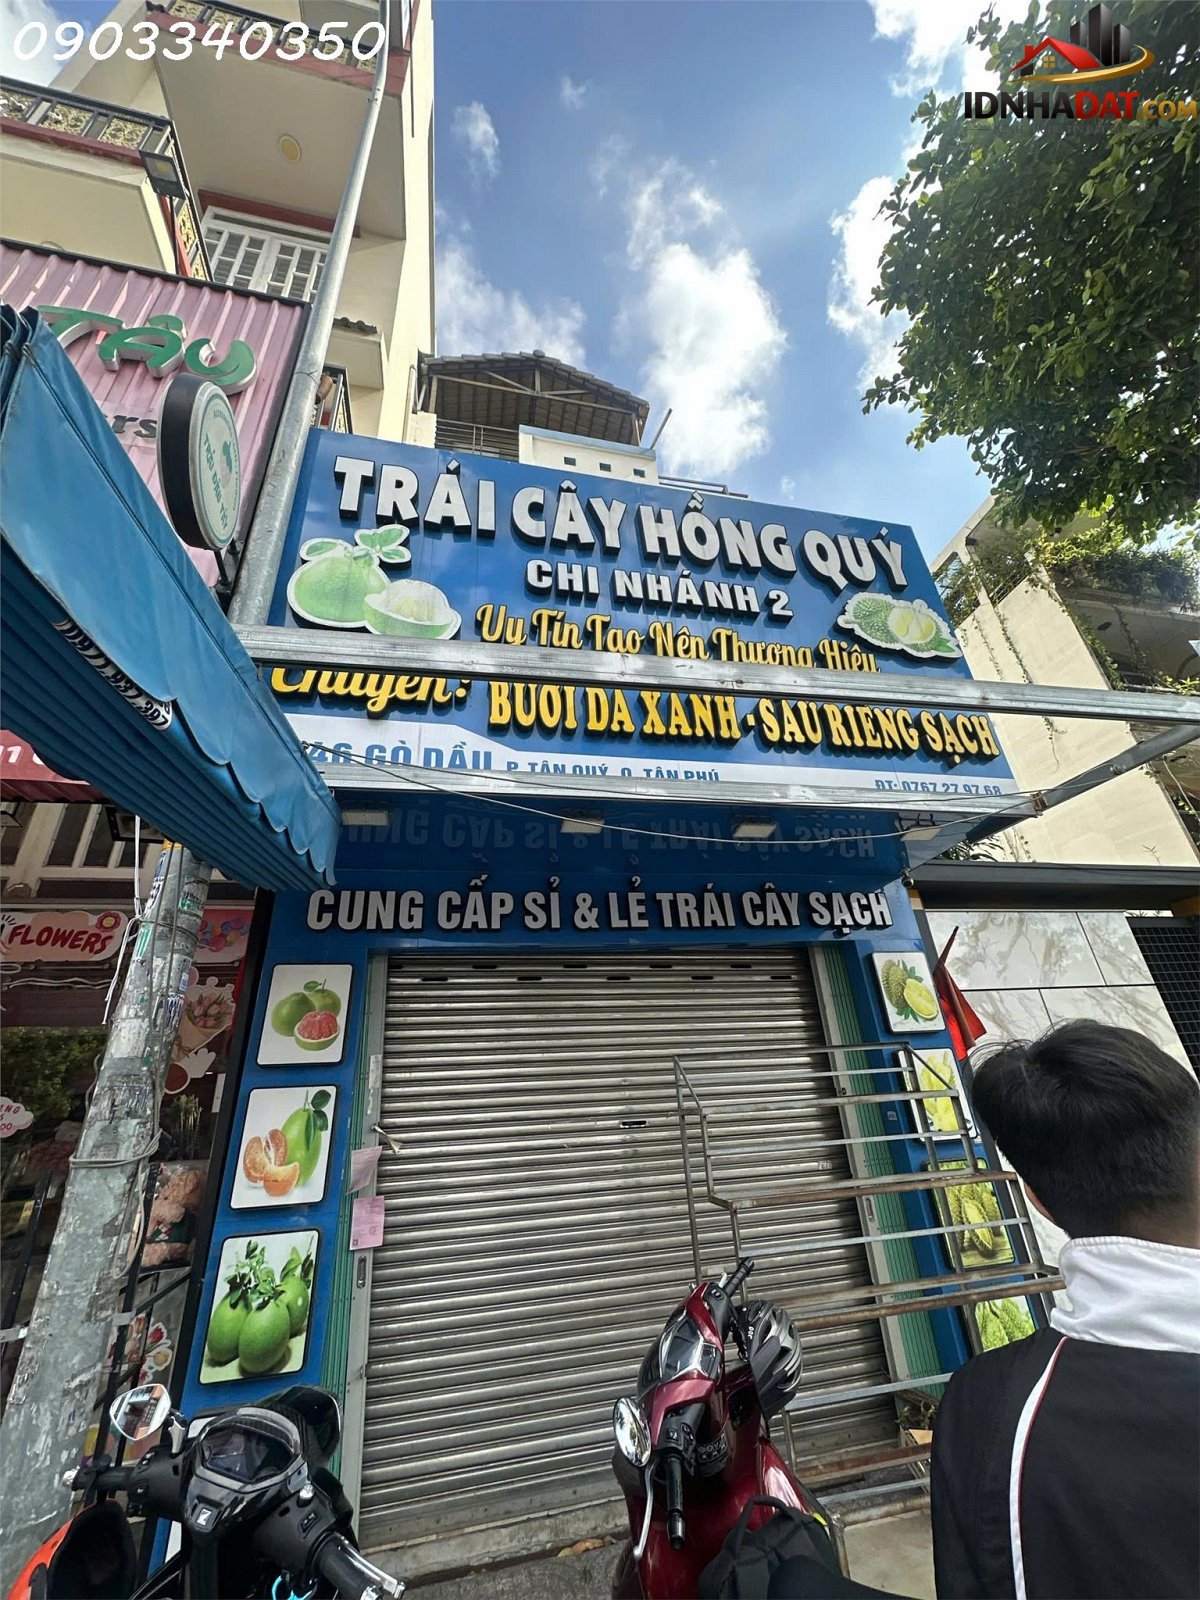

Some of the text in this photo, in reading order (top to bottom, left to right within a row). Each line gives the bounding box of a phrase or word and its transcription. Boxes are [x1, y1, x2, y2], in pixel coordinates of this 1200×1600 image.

[334, 456, 908, 591] TRÁI CÂY HỒNG QUÝ
[527, 559, 793, 617] CHI NHÁNH 2
[532, 608, 583, 649] Tín
[649, 621, 710, 661] Nên
[640, 690, 742, 739] XANH
[921, 709, 1000, 764] SẠCH
[528, 760, 566, 774] TÂN
[306, 874, 894, 934] CUNG CẤP SỈ & LẺ TRÁI CÂY SẠCH
[8, 924, 114, 955] FLOWERS
